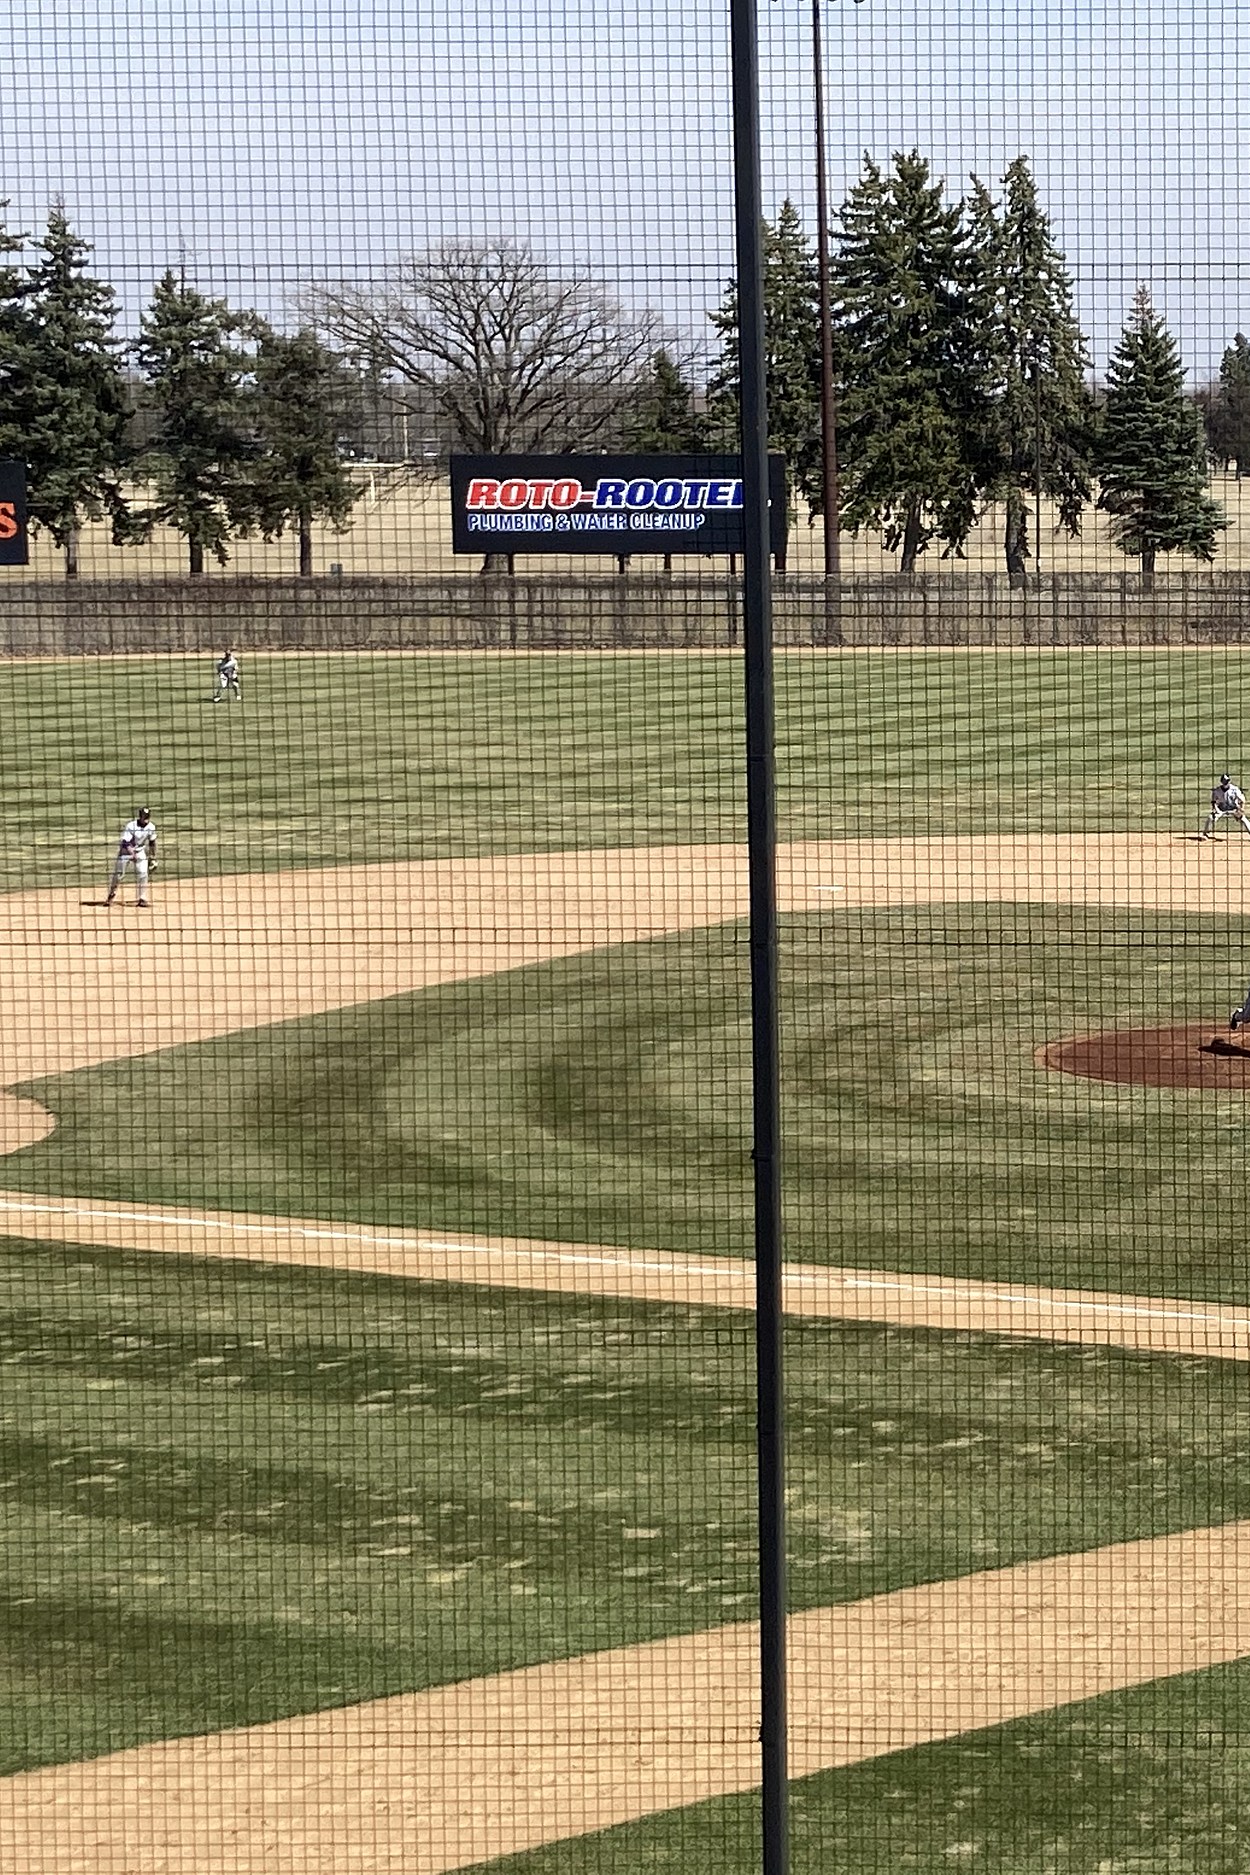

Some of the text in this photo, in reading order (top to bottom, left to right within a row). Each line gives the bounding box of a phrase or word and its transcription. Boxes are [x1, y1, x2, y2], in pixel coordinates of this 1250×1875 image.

[468, 513, 706, 532] PLUMBING & WATER CLEANUP
